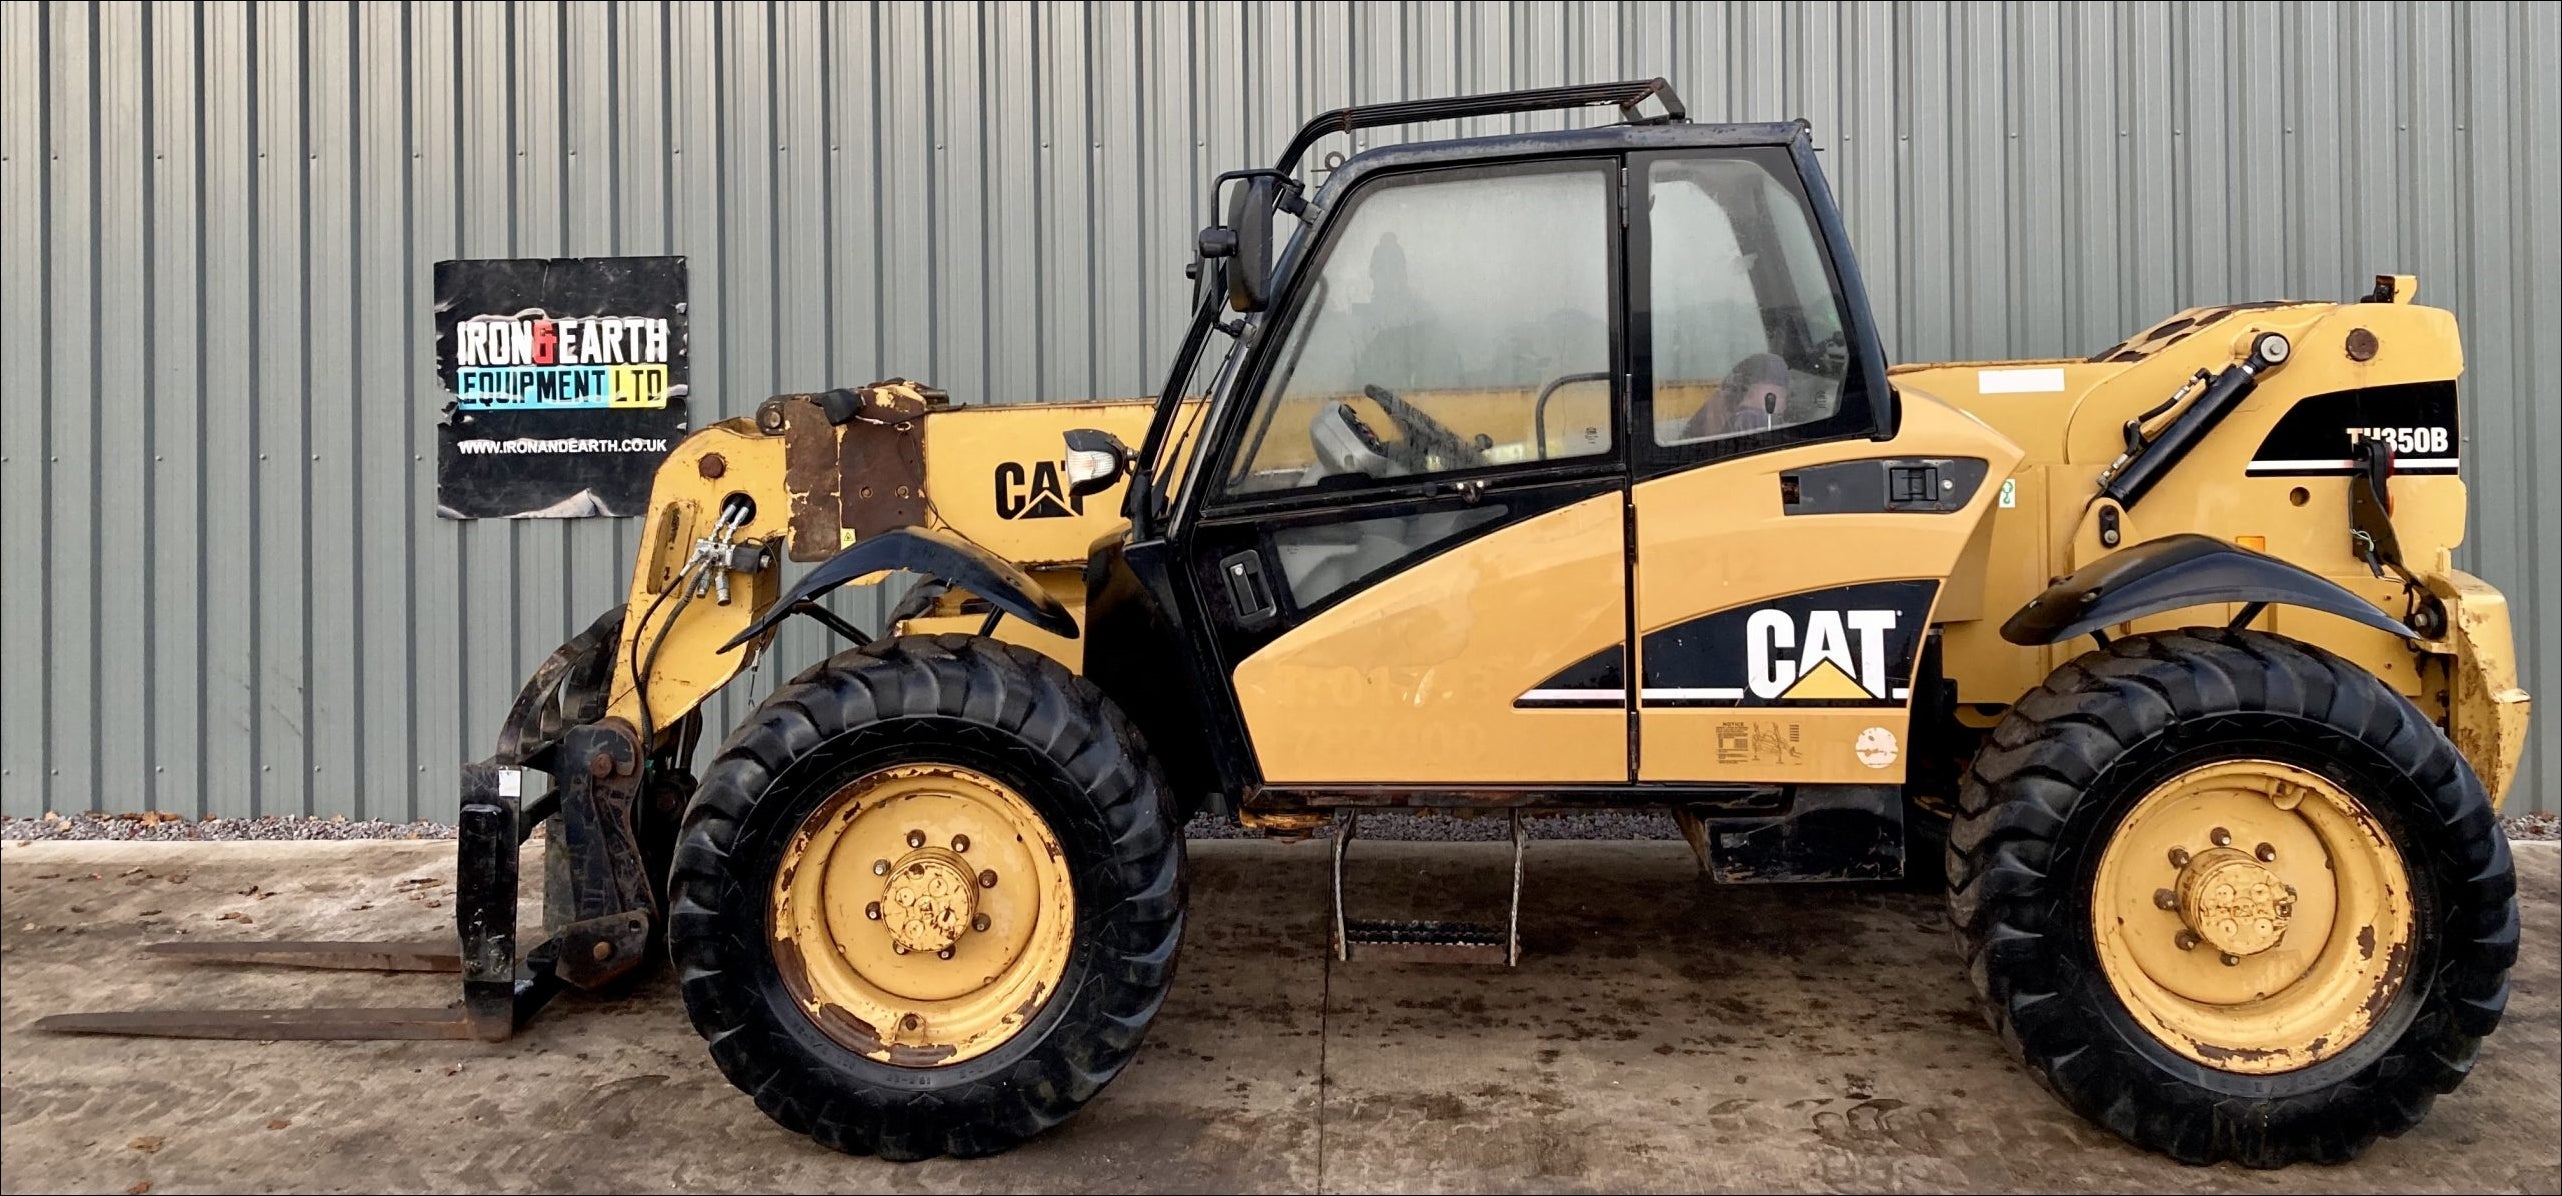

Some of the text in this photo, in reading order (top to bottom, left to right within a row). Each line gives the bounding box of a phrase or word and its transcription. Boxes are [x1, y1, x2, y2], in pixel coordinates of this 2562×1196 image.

[463, 369, 662, 406] EQUIPMENT LTD
[457, 440, 667, 454] WWW.IRONANDEARTH.CO.UK
[1746, 608, 1897, 699] CAT
